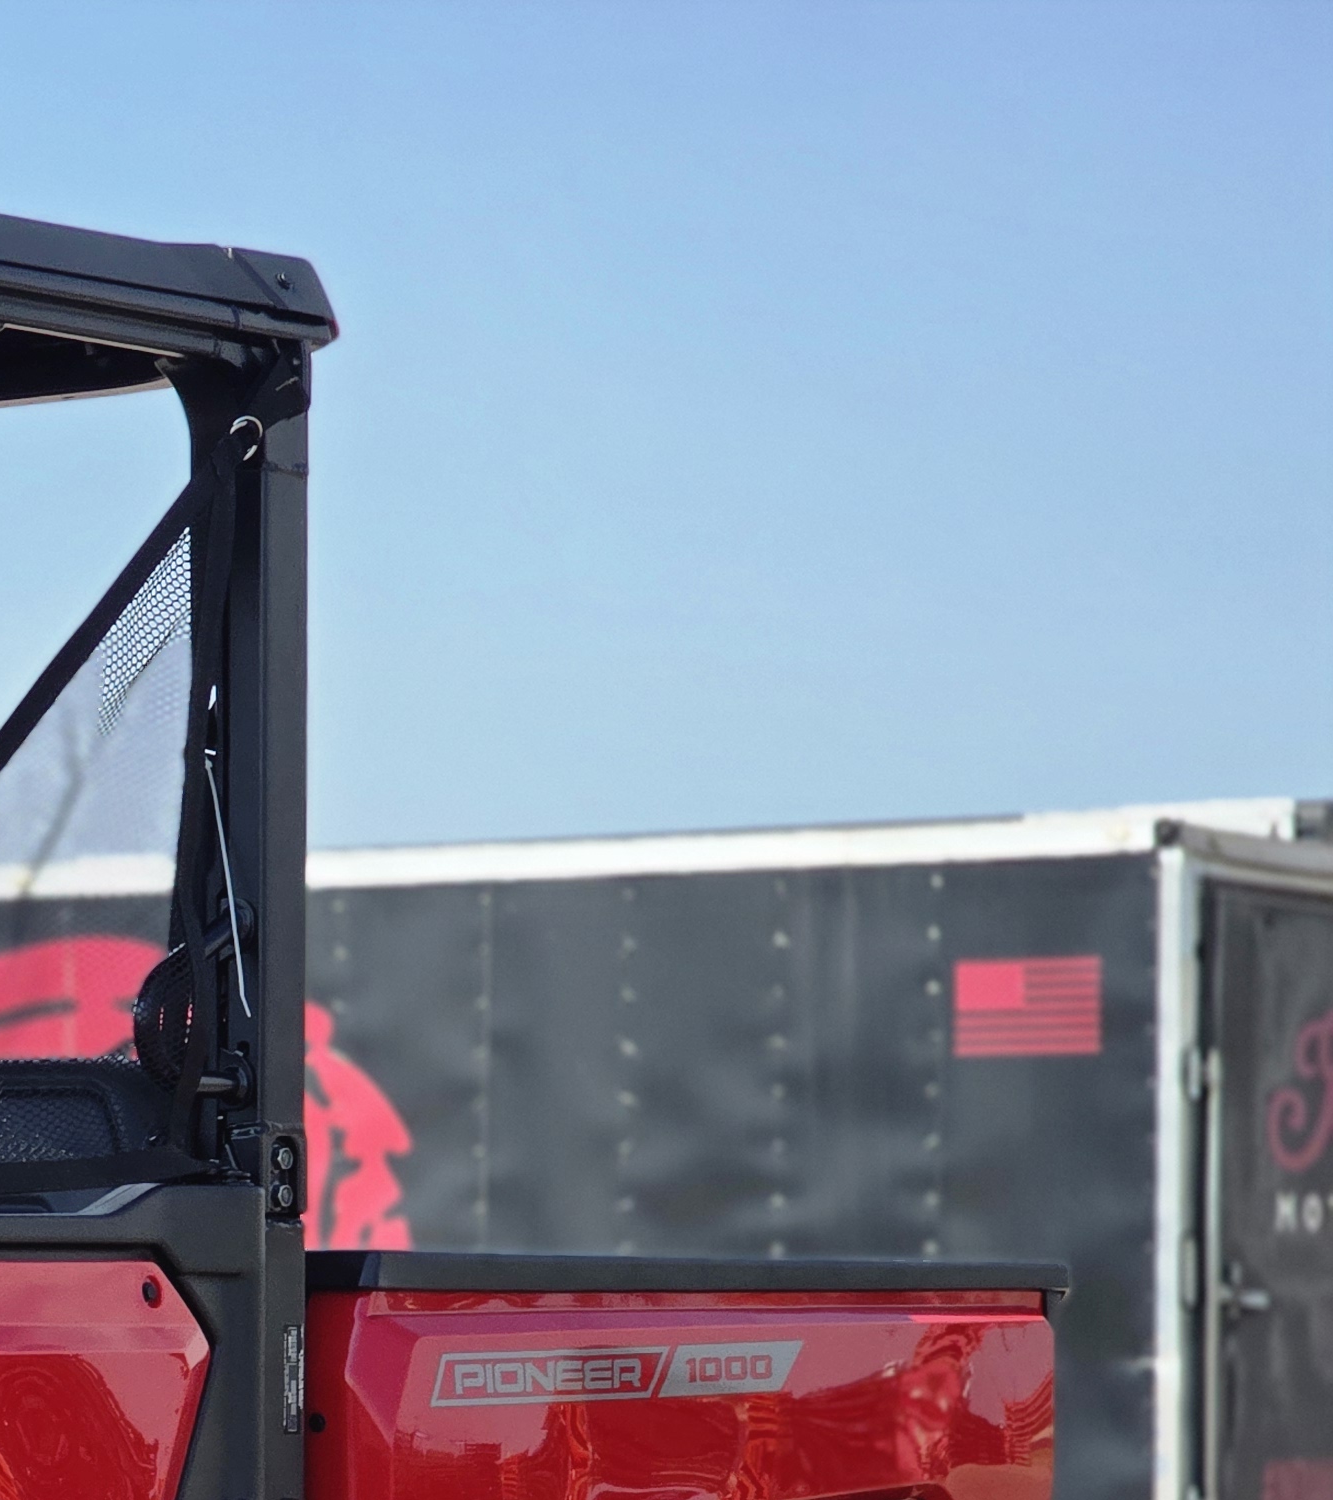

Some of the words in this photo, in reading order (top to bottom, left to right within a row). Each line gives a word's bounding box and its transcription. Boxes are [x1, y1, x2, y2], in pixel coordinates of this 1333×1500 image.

[1275, 1191, 1333, 1233] MO
[454, 1358, 641, 1395] PIONEER
[686, 1353, 773, 1384] 1000
